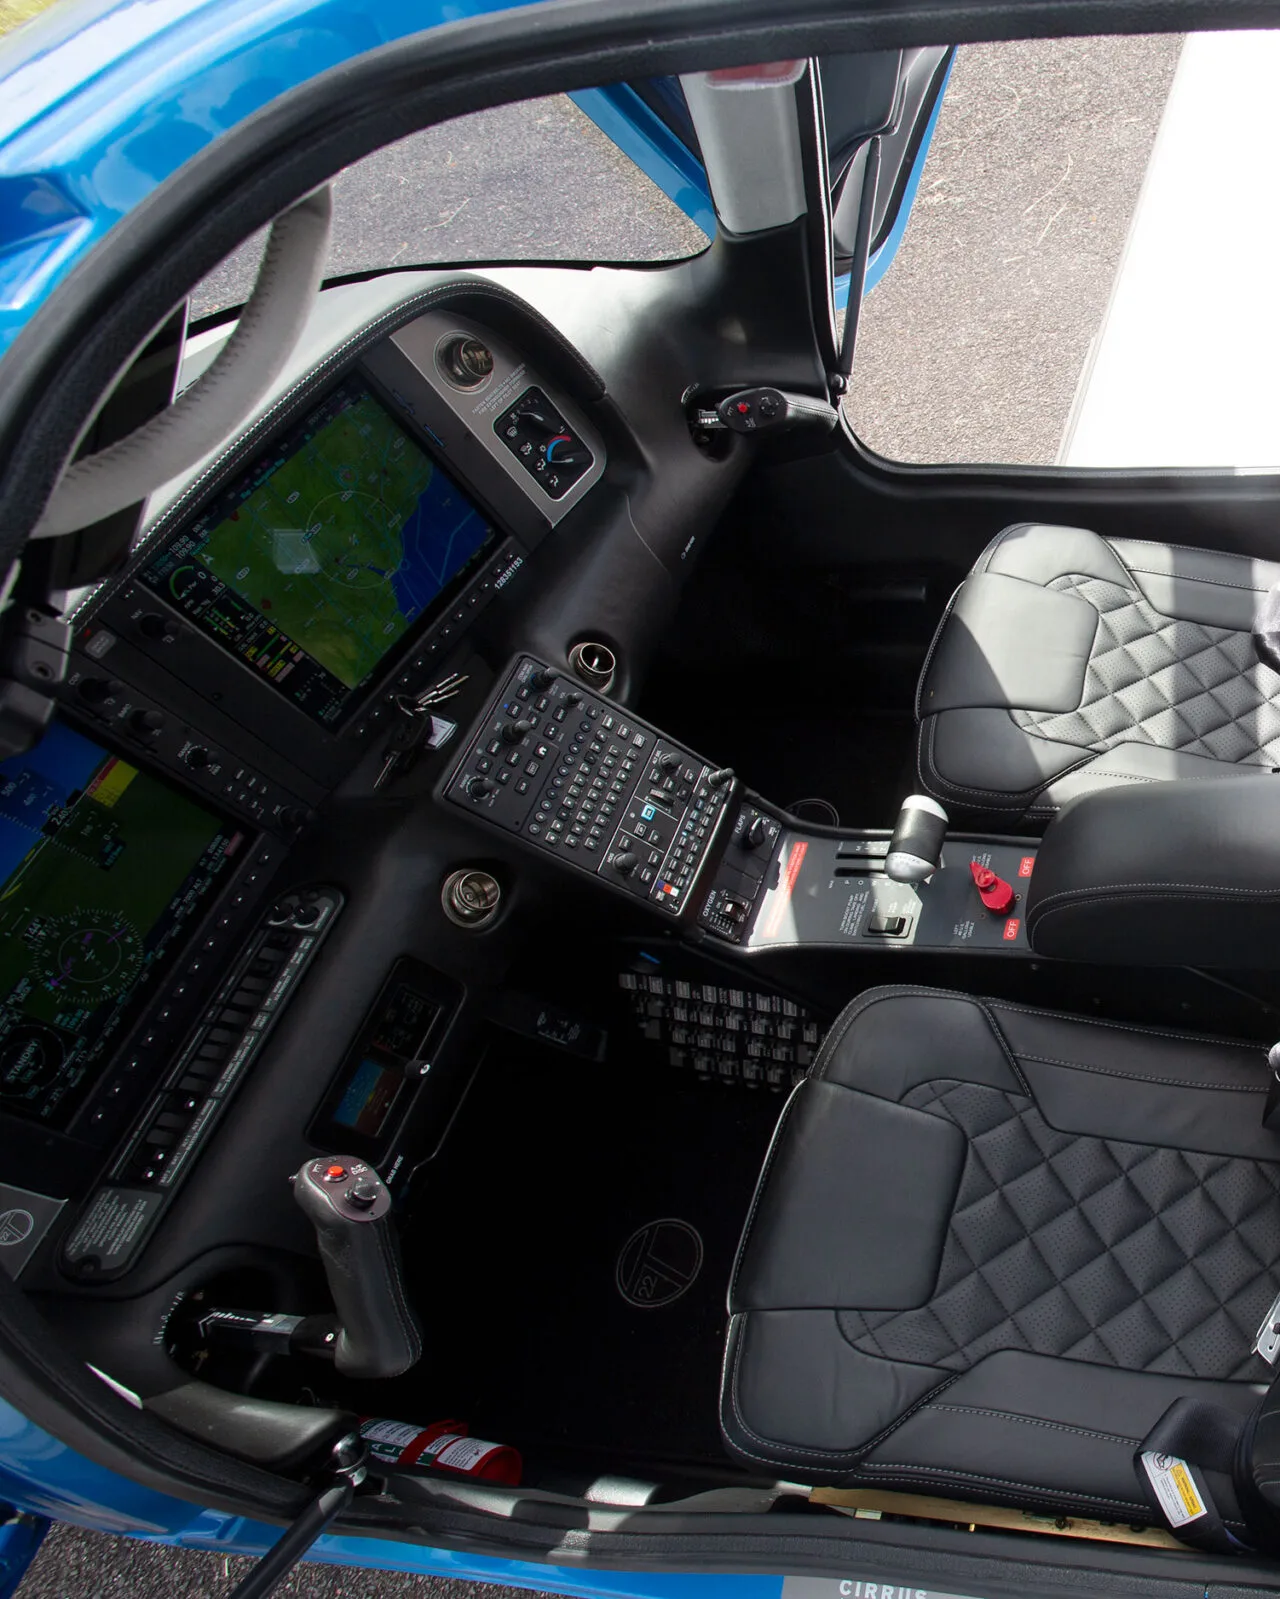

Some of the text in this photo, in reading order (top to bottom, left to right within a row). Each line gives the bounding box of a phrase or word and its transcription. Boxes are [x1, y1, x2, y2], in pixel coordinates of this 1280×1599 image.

[492, 556, 524, 590] 128351193
[734, 814, 745, 833] FLAPS
[1021, 858, 1031, 875] OFF
[702, 889, 716, 916] OXYGEN
[1006, 920, 1016, 938] OFF
[4, 1038, 39, 1084] STANDBY
